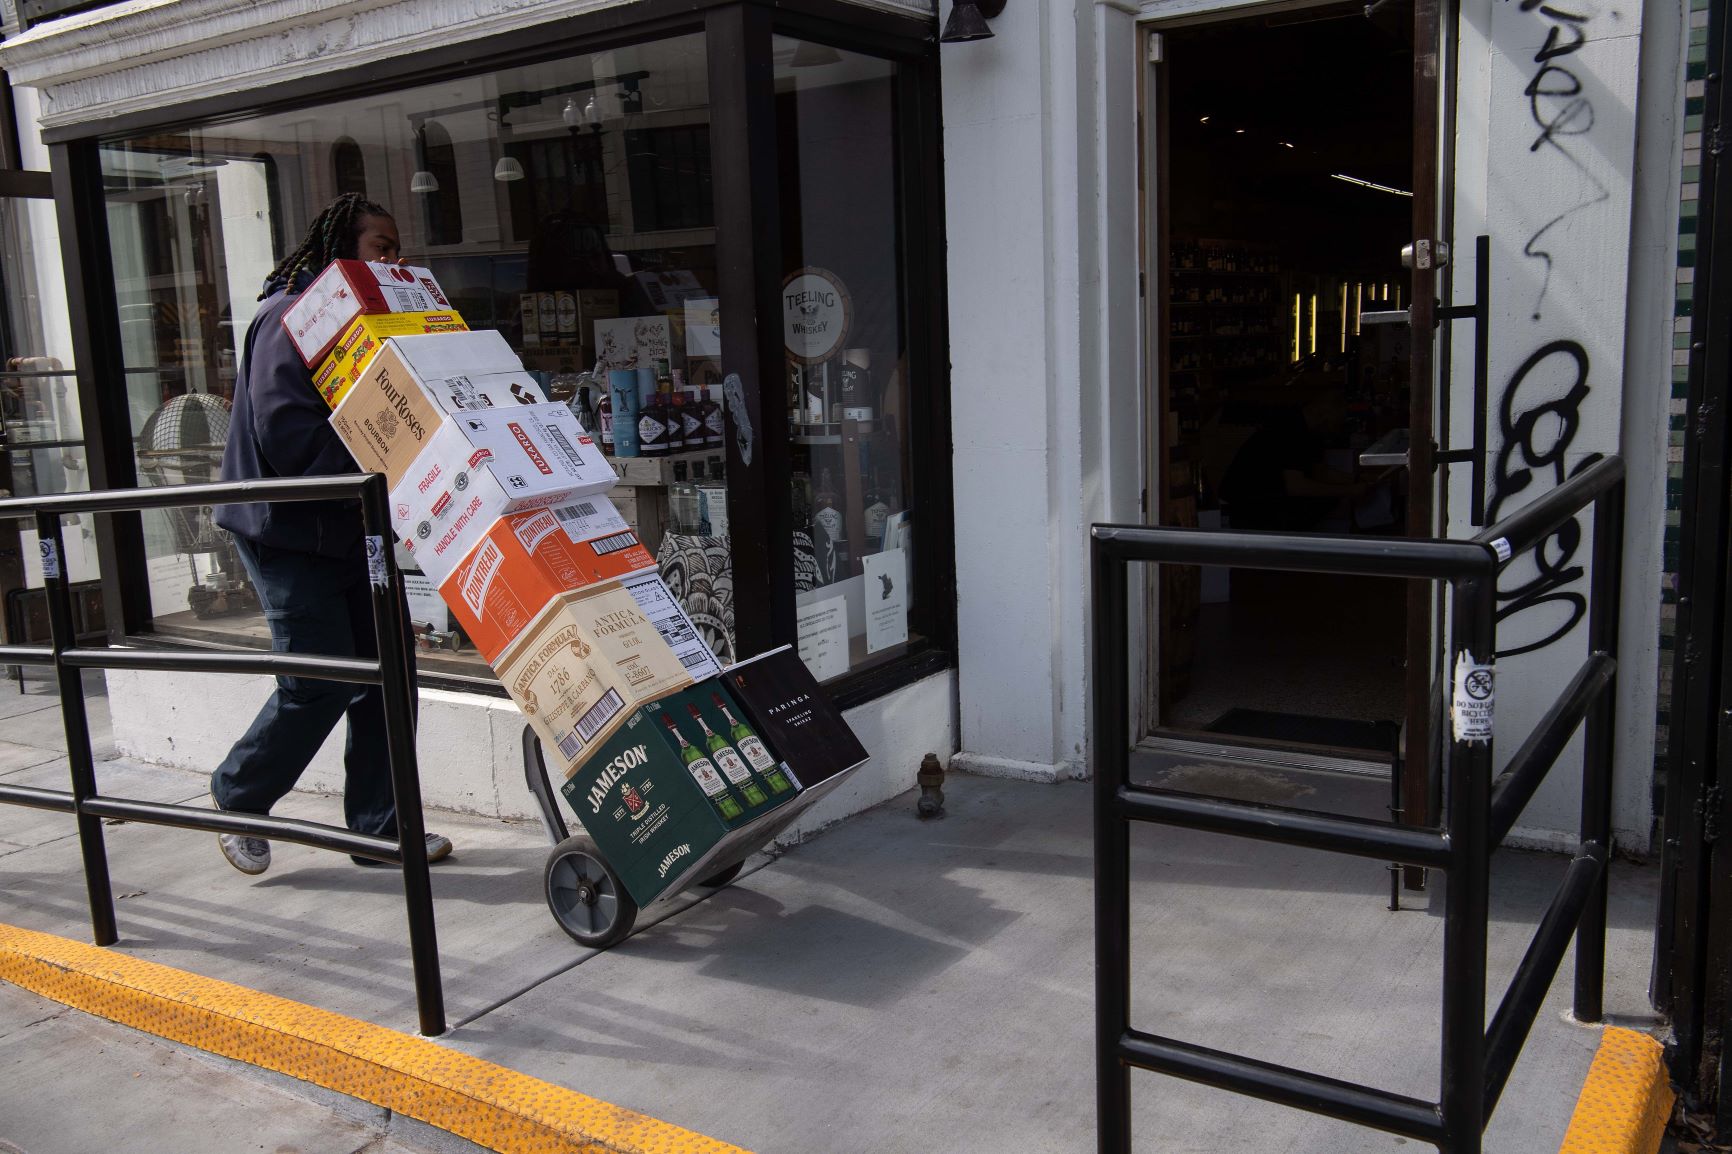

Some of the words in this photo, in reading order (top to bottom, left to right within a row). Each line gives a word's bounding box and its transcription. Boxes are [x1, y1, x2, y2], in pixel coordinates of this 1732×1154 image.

[785, 290, 835, 311] TEELING
[344, 326, 364, 351] LUXARDO
[792, 321, 828, 335] WHISKEY
[316, 362, 336, 385] LUXARDO
[363, 418, 390, 454] BOURBON
[511, 424, 549, 473] LUXARDO
[416, 463, 442, 494] FRAGILE
[432, 492, 450, 514] LUXARDO
[432, 526, 458, 556] HANDLE
[452, 510, 470, 531] WITH
[465, 495, 483, 517] CARE
[519, 513, 555, 548] COINTREAU
[466, 544, 498, 610] COINTREAU
[592, 616, 646, 638] FORMULA
[594, 608, 634, 628] ANTICA
[515, 659, 542, 691] ANTICA
[537, 628, 575, 662] FORMULA
[542, 697, 570, 725] GIUSEPPE
[571, 668, 597, 699] CARPANO
[548, 667, 572, 695] 1786
[768, 694, 811, 715] PARINGA
[785, 709, 812, 724] SPARKLING
[585, 743, 648, 814] JAMESON
[688, 757, 709, 773] JAMESON
[629, 822, 645, 839] TRIPLE
[643, 802, 666, 825] DISTILLED
[638, 830, 651, 845] IRISH
[648, 812, 669, 834] WHISKEY
[657, 843, 691, 878] JAMESON
